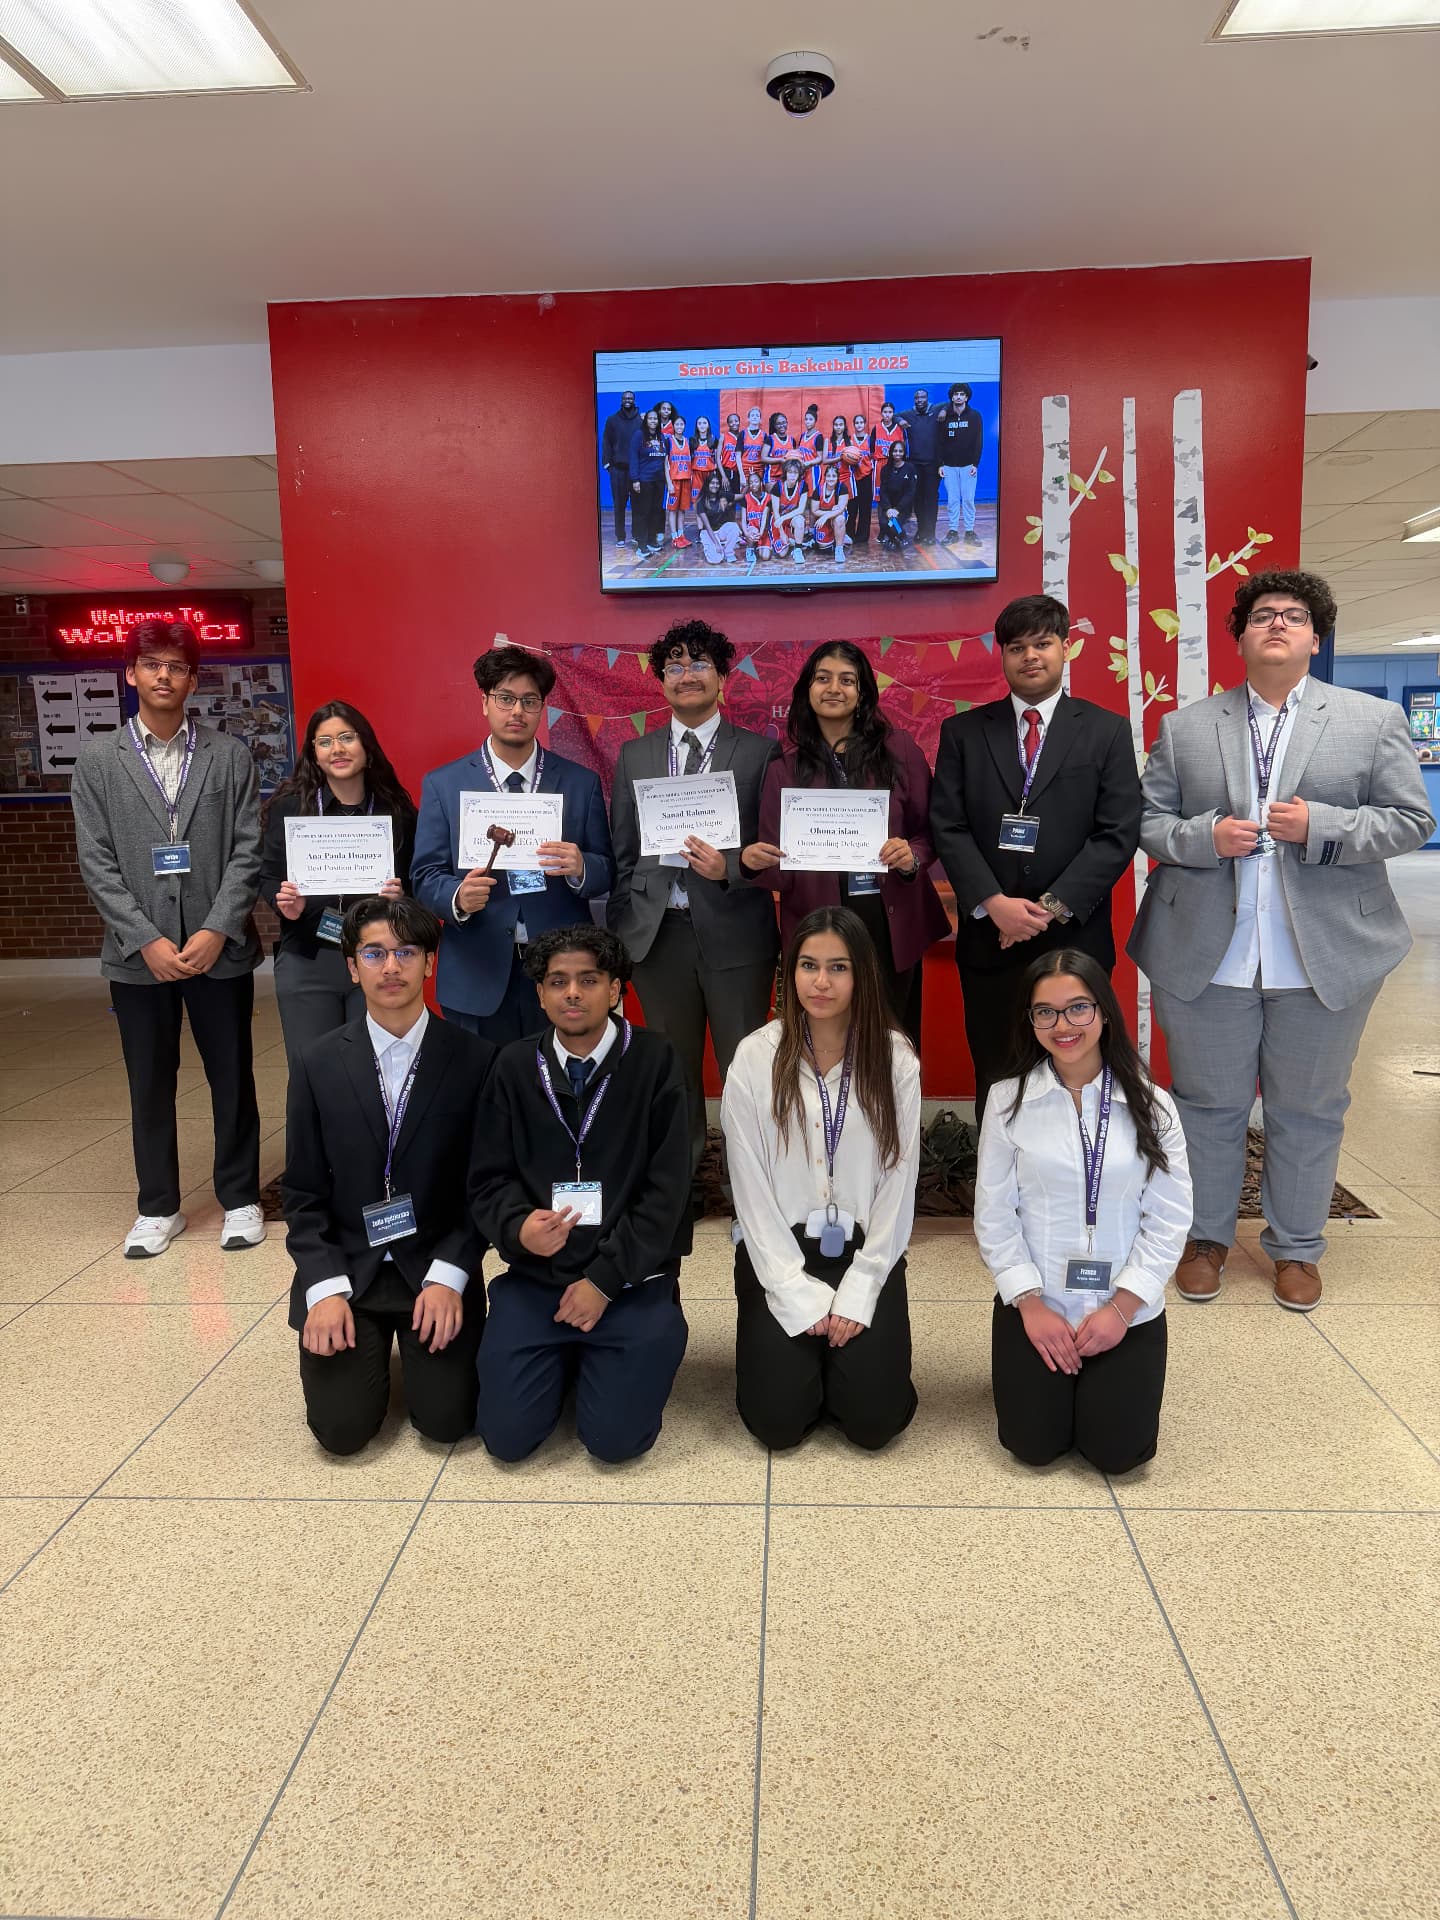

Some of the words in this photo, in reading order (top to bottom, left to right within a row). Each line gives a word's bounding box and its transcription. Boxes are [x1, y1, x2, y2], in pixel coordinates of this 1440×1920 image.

[679, 362, 732, 377] Senior
[735, 360, 774, 375] Girls
[778, 356, 864, 374] Basketball
[867, 355, 910, 371] 2025
[90, 609, 175, 625] Welcome
[179, 607, 205, 623] To
[199, 624, 241, 640] CI
[686, 808, 716, 817] Rahman
[656, 822, 695, 831] Outstanding
[696, 820, 723, 828] Delegate
[473, 837, 491, 846] BES
[797, 840, 839, 848] Outstanding
[841, 840, 869, 848] Delegate
